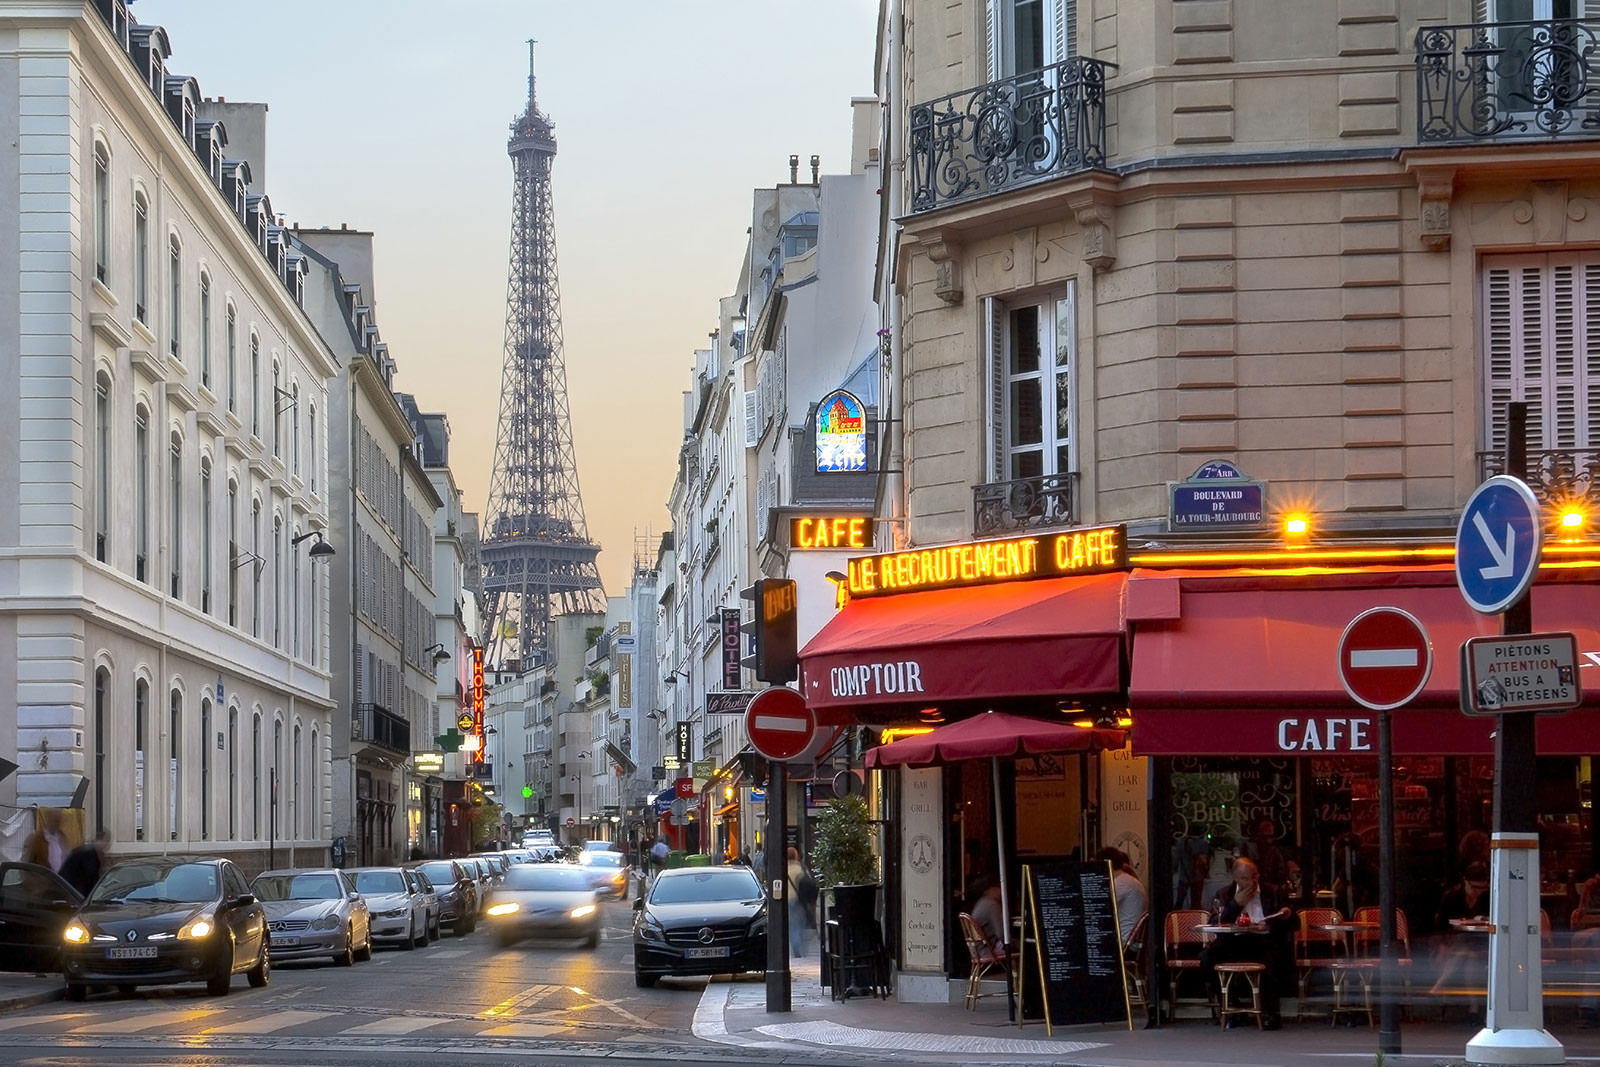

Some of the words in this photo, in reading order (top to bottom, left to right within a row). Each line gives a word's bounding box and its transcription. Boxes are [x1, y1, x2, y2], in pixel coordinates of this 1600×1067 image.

[1193, 491, 1243, 500] BOULEVARD
[1212, 502, 1225, 511] DE
[1175, 514, 1186, 523] LA
[1188, 512, 1261, 522] TOUR-MAUBOURG
[799, 518, 865, 548] CAFE
[848, 558, 876, 592] LE
[881, 539, 1037, 589] RECRUTEMENT
[1055, 530, 1118, 570] CAFE
[724, 620, 739, 688] HOTEL
[1488, 659, 1558, 673] ATTENTION
[830, 661, 924, 697] COMPTOIR
[1504, 676, 1529, 687] BUS
[1536, 675, 1544, 685] A
[1500, 687, 1569, 702] NTRESENS
[1278, 718, 1371, 751] CAFE
[1118, 775, 1138, 785] BAR
[910, 804, 930, 813] GRILL
[1112, 800, 1140, 812] GRILL
